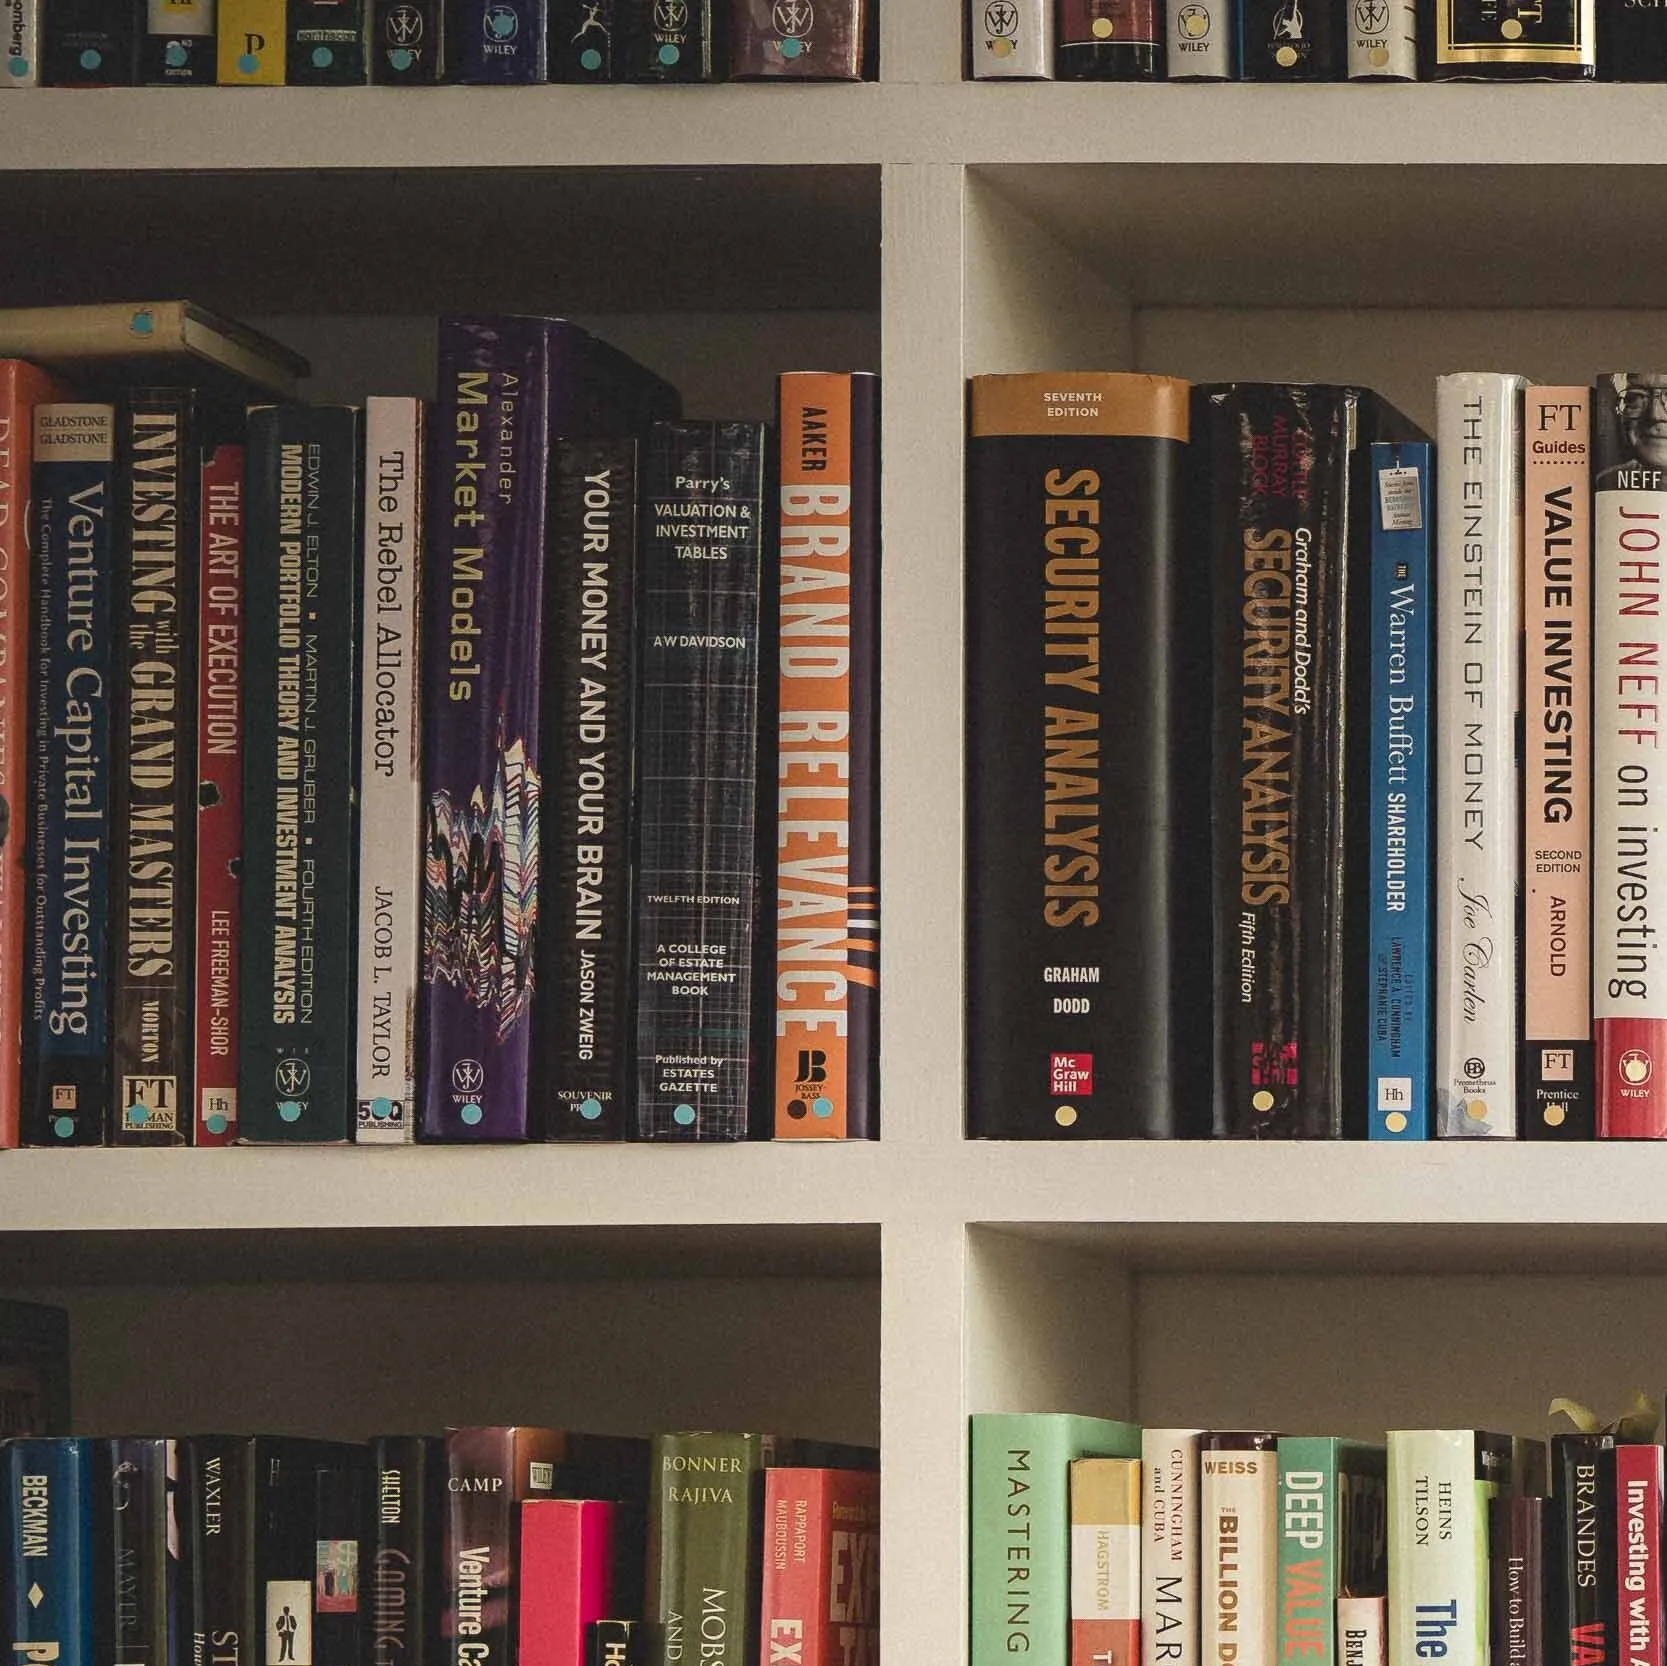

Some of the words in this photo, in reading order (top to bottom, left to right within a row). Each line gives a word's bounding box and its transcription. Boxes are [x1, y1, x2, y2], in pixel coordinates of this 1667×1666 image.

[1177, 42, 1211, 53] WILEY
[1044, 393, 1102, 401] SEVENTH
[1048, 408, 1098, 416] EDITION
[1539, 405, 1581, 430] FT
[454, 372, 488, 527] Market
[802, 407, 827, 471] AAKER
[1533, 441, 1586, 454] Guides
[378, 452, 403, 514] The
[676, 476, 730, 493] Parry's
[1617, 471, 1662, 490] NEFF
[66, 482, 104, 651] Venture
[378, 524, 403, 619] Rebel
[675, 544, 728, 560] TABLES
[1544, 486, 1572, 607] VALUE
[780, 484, 850, 679] BRAND
[1045, 469, 1100, 694] SECURITY
[449, 548, 484, 700] Models
[375, 627, 402, 777] Allocator
[1544, 621, 1572, 823] INVESTING
[54, 667, 103, 820] Capital
[1044, 706, 1099, 927] ANALYSIS
[777, 709, 849, 1039] RELEVANCE
[48, 840, 101, 1035] Investing
[1550, 896, 1566, 976] ARNOLD
[1044, 967, 1099, 982] GRAHAM
[1054, 998, 1090, 1013] DODD
[448, 1477, 503, 1492] CAMP
[663, 1456, 742, 1473] BONNER
[668, 1486, 733, 1504] RAJIVA
[1205, 1462, 1257, 1474] WEISS
[1007, 1450, 1030, 1652] MASTERING
